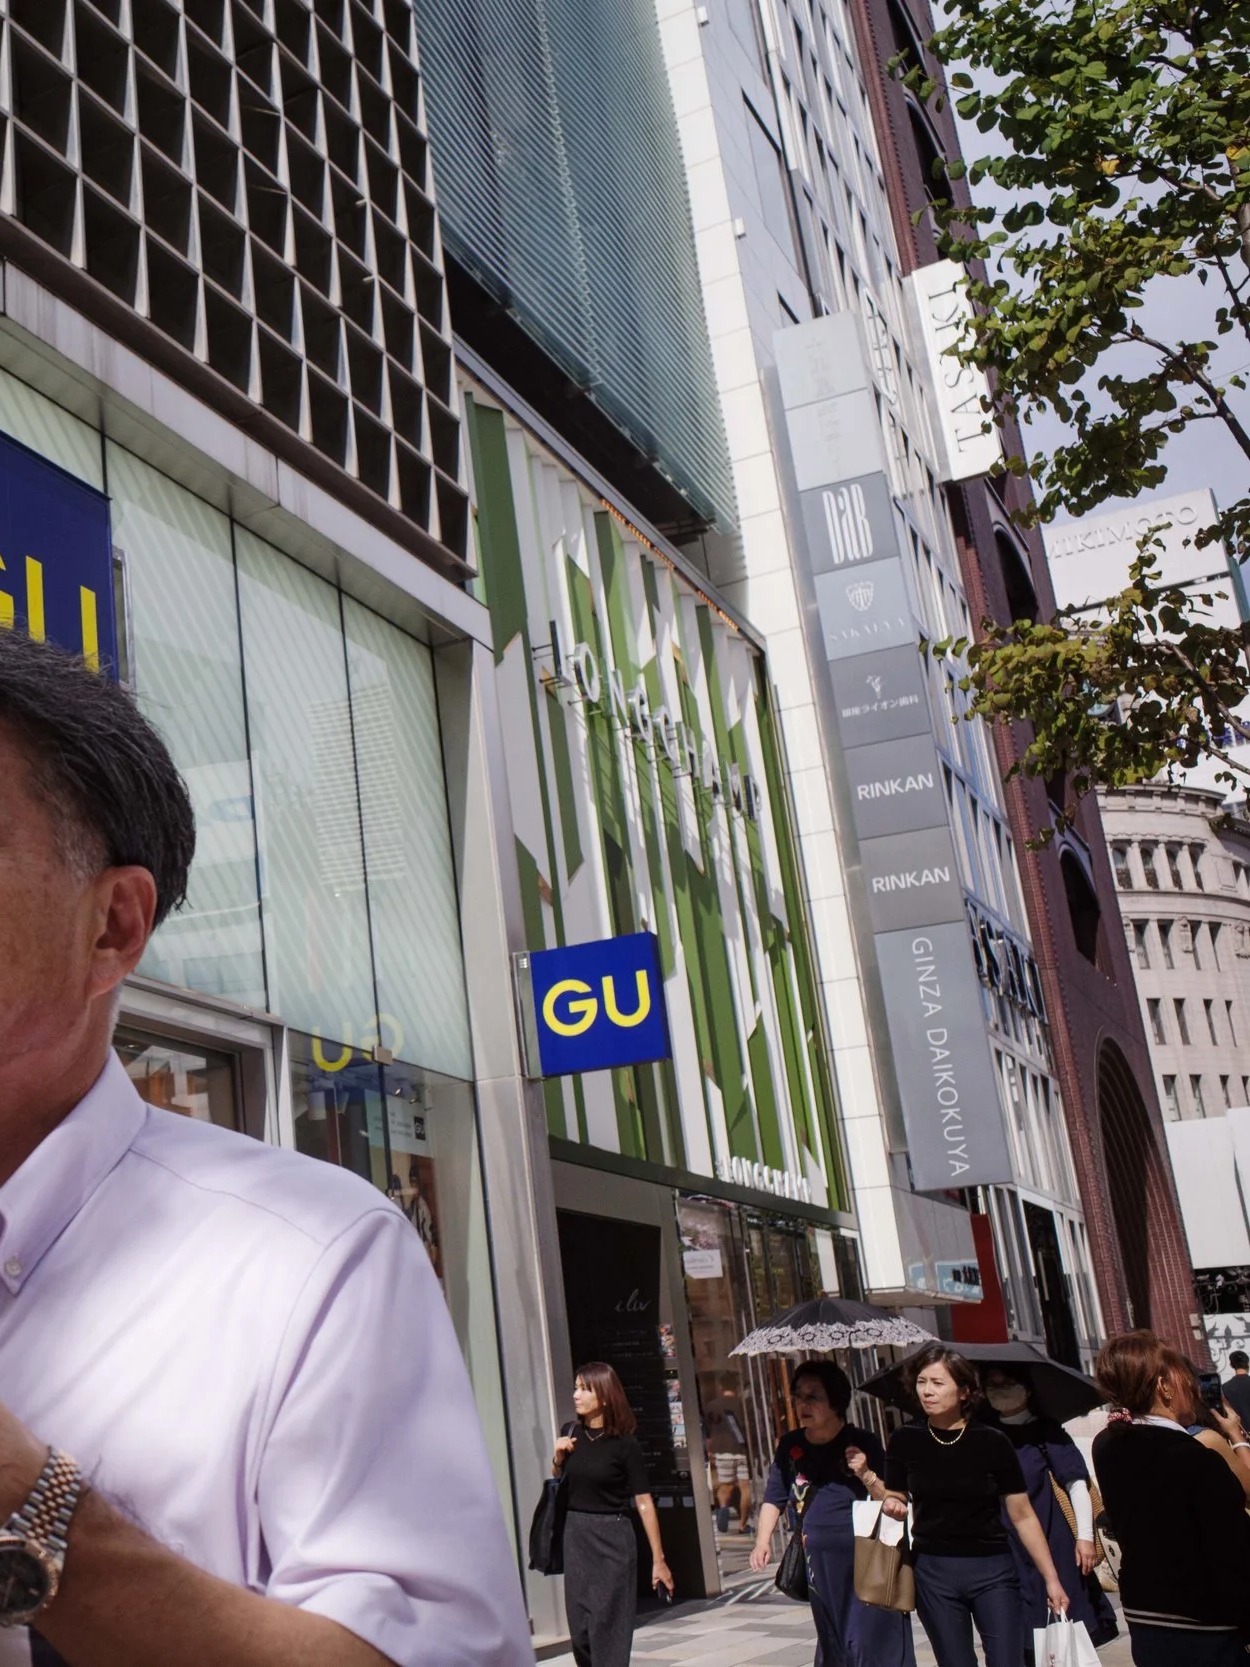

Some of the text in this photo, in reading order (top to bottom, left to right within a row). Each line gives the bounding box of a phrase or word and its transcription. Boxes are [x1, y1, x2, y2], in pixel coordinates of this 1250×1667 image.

[928, 288, 986, 453] TASKI
[857, 773, 934, 800] RINKAN
[872, 866, 951, 893] RINKAN
[543, 969, 651, 1037] GU
[912, 936, 971, 1177] GINZA DAIKOKUYA
